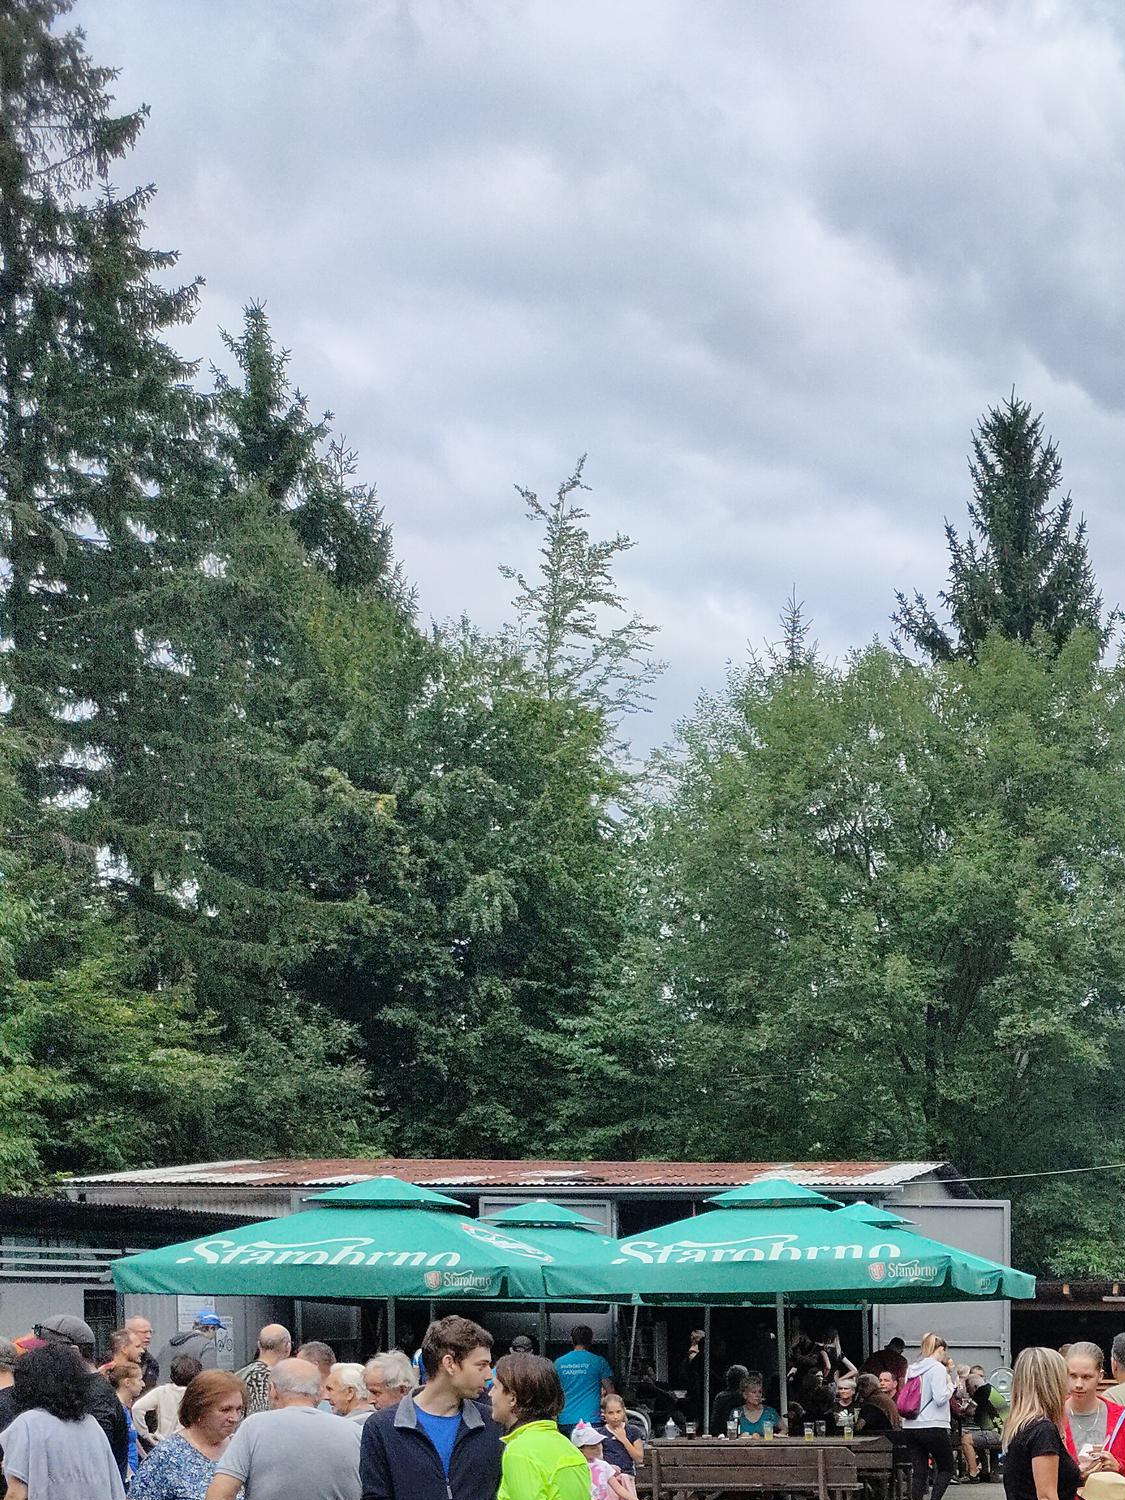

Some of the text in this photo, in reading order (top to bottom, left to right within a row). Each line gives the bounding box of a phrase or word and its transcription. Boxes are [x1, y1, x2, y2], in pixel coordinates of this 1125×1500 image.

[611, 1234, 902, 1265] Starobrno
[443, 1269, 493, 1294] Starobrno
[888, 1259, 938, 1282] Starobrno
